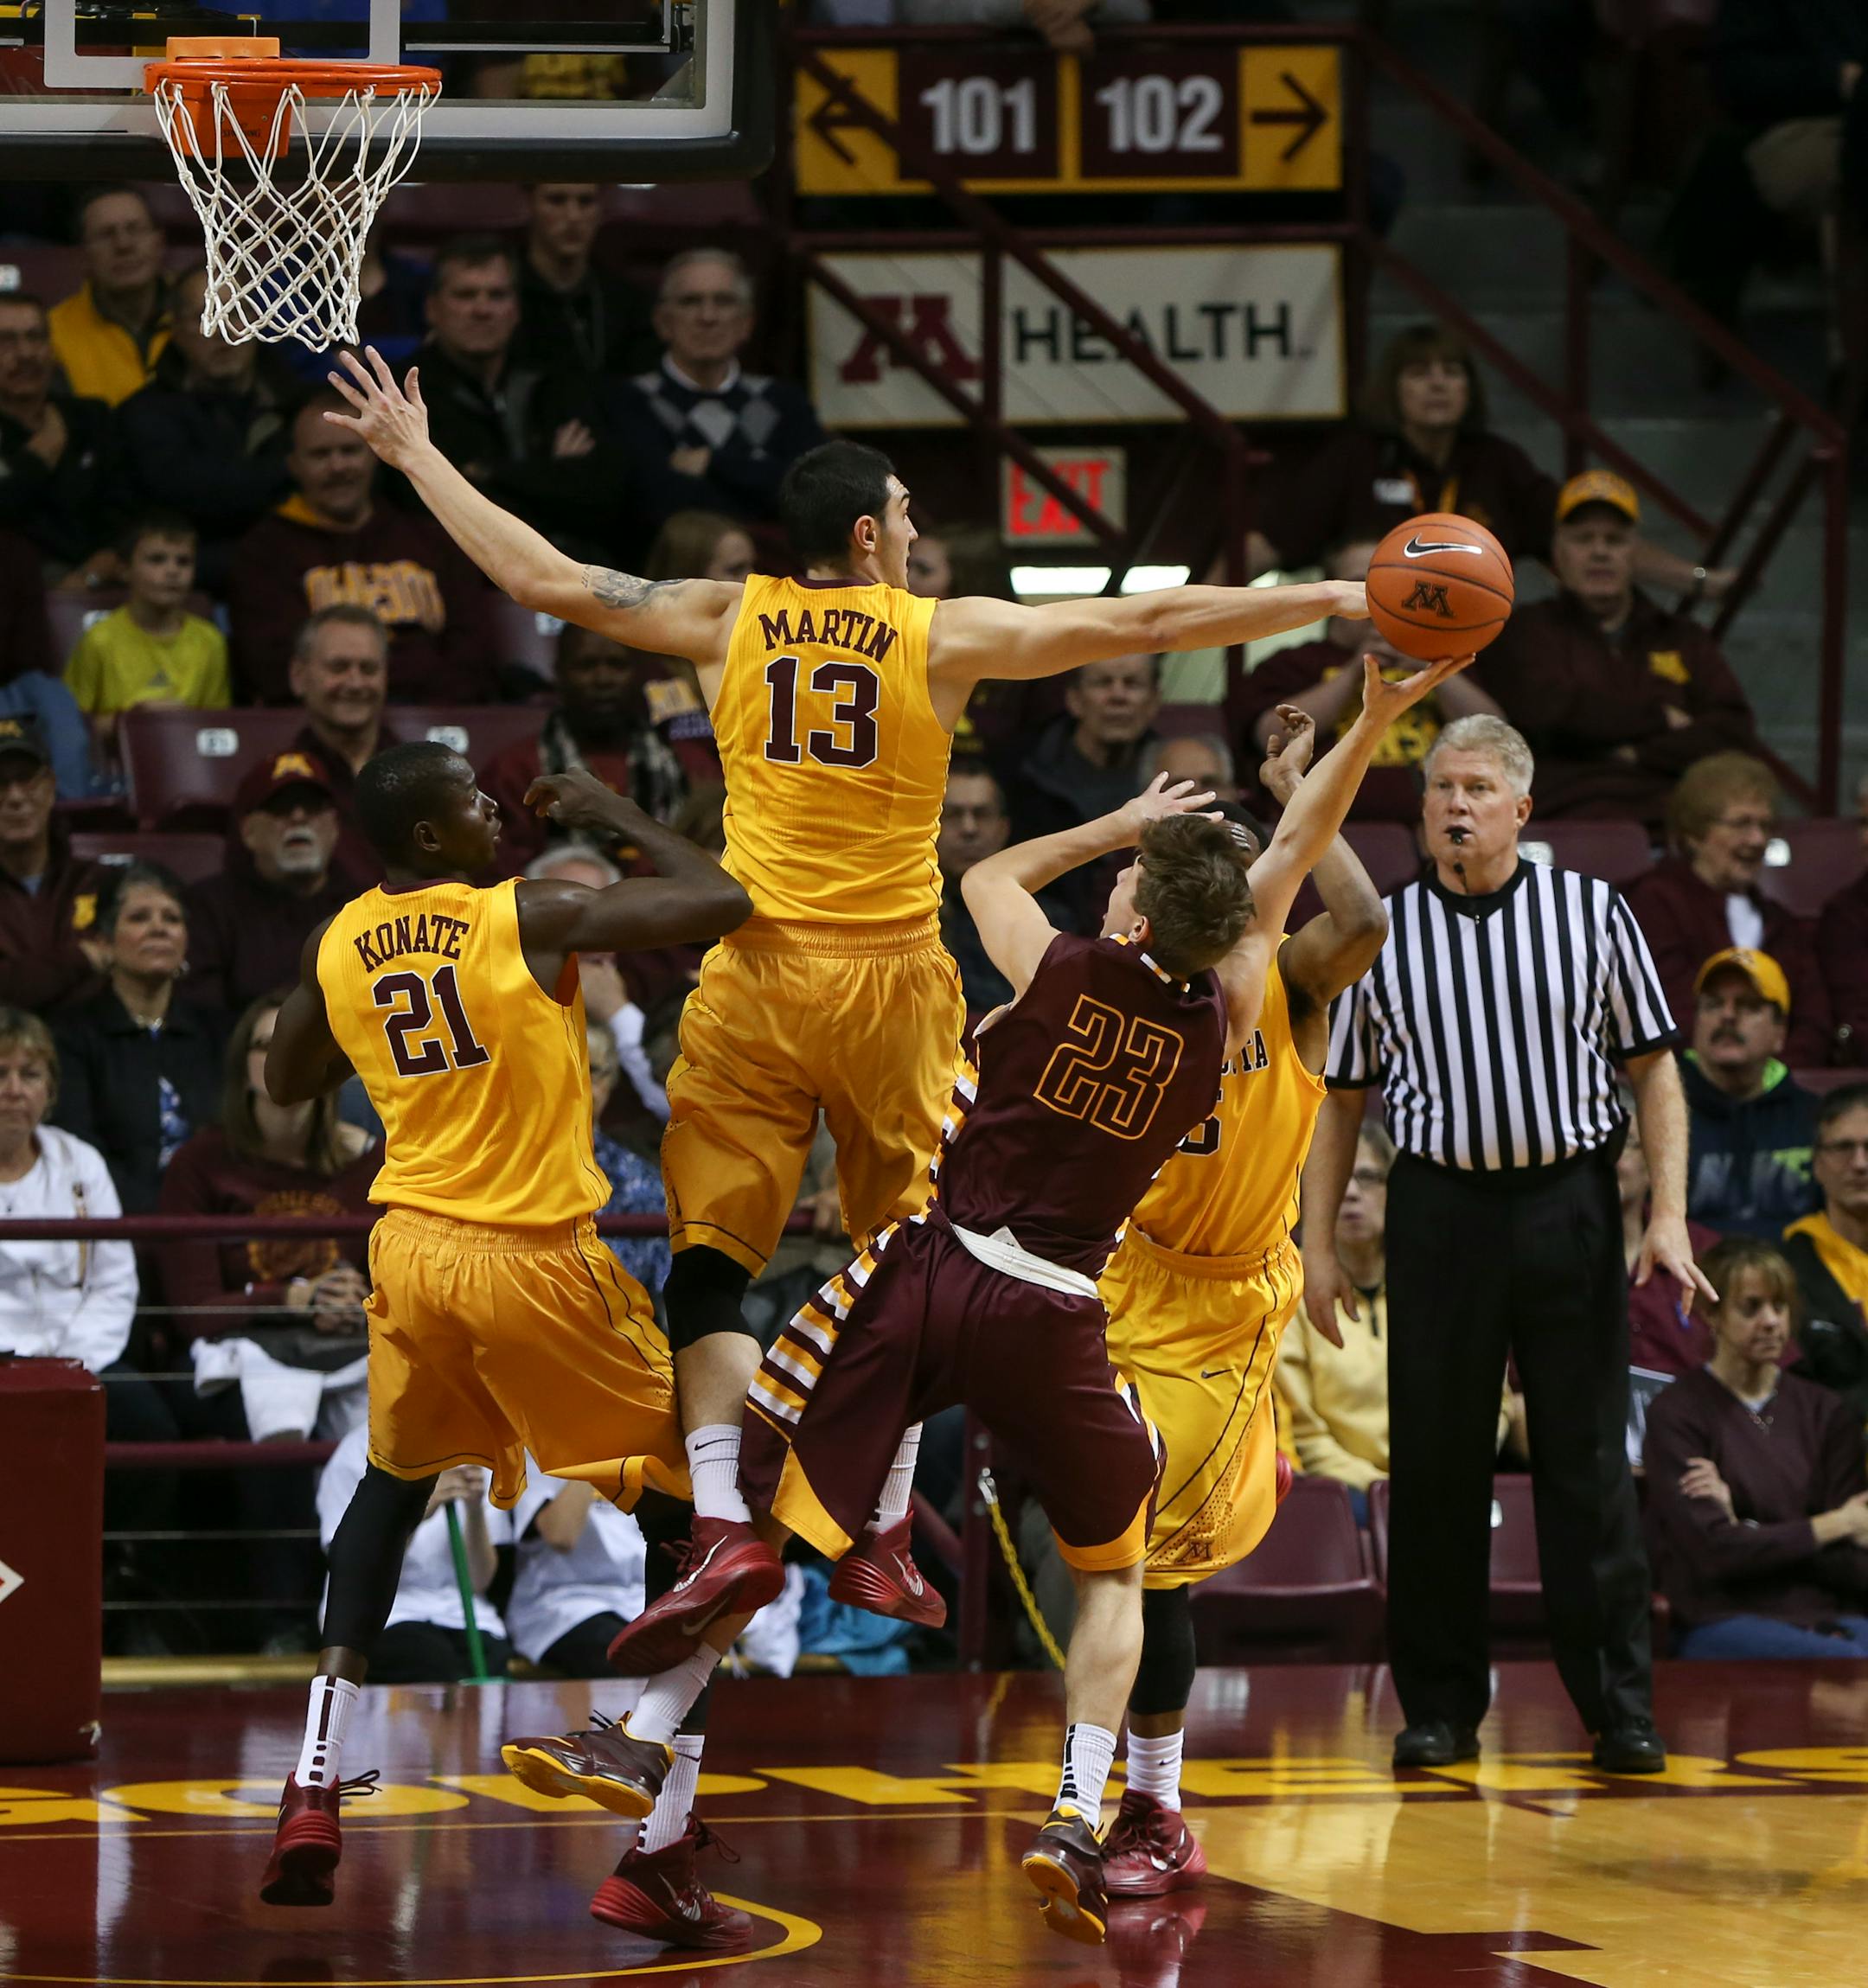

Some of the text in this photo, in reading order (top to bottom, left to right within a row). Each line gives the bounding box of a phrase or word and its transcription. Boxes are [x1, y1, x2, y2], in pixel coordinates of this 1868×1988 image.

[919, 76, 1037, 154] 101
[1095, 74, 1225, 154] 102
[1014, 302, 1290, 363] HEALTH
[1010, 459, 1110, 536] EXIT
[758, 609, 898, 663] MARTIN
[764, 655, 880, 770] 13
[354, 914, 470, 974] KONATE
[371, 964, 491, 1078] 21
[1033, 994, 1184, 1140] 23
